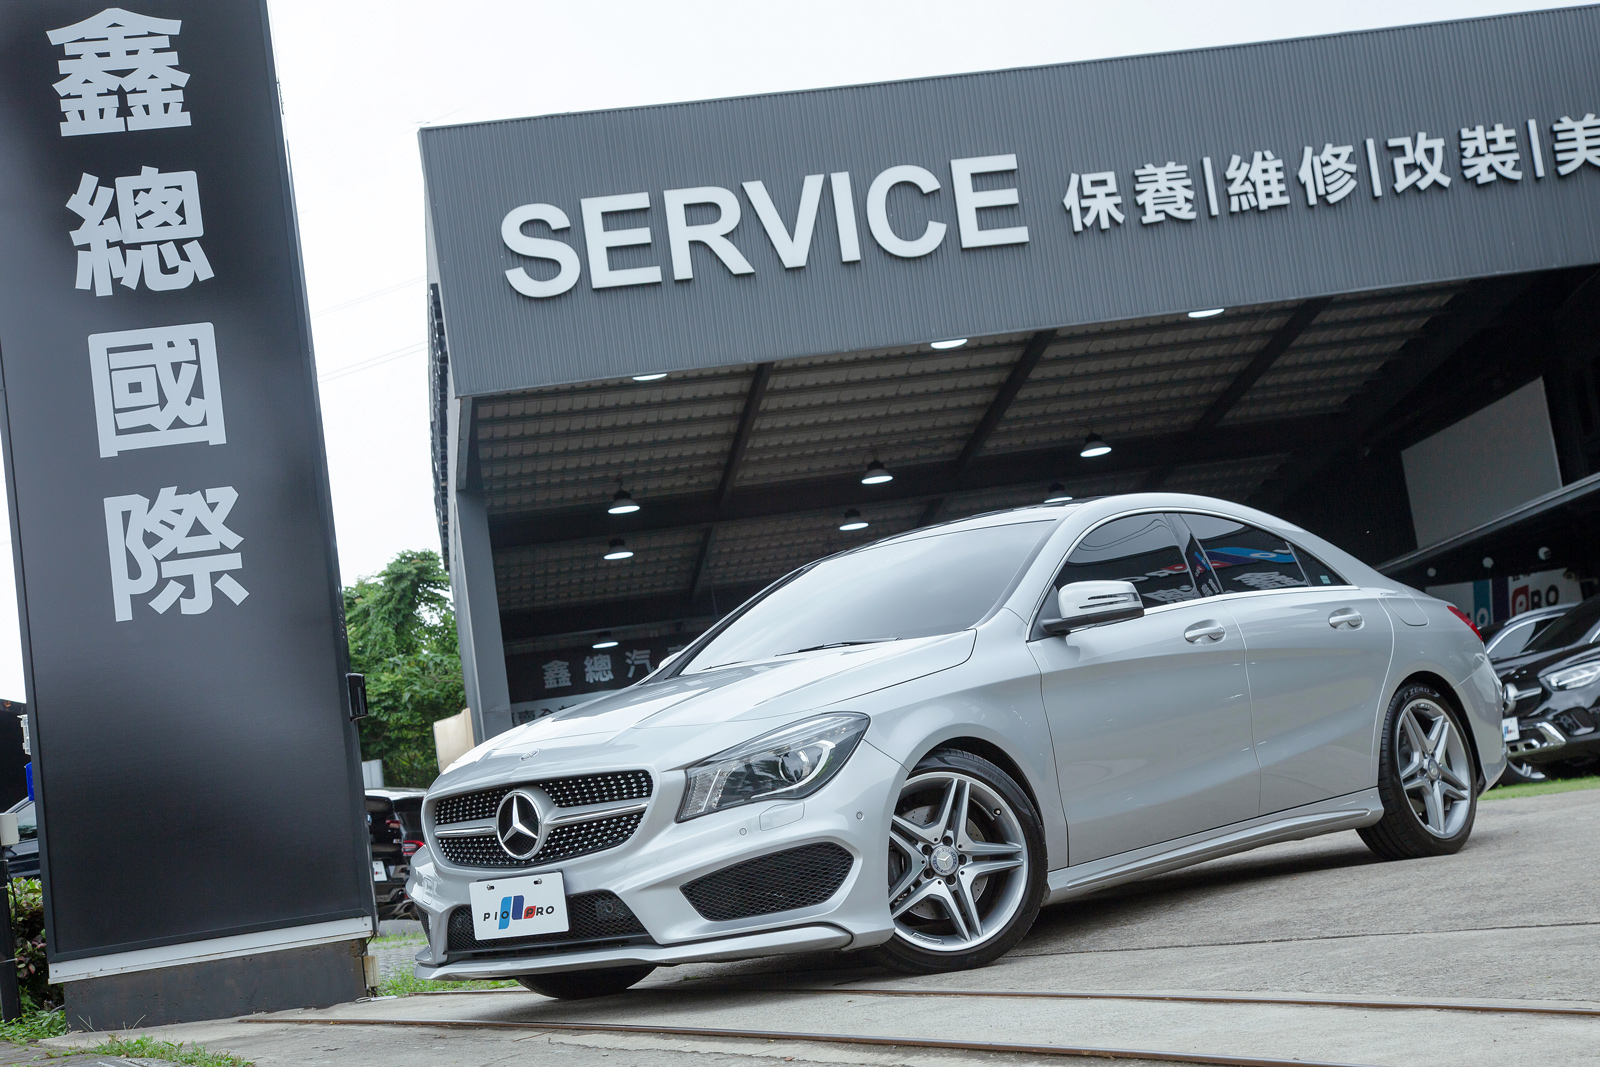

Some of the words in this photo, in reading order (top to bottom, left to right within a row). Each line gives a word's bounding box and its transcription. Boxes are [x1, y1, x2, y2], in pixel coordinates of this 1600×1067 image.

[500, 153, 1030, 298] SERVICE
[46, 7, 250, 622] 鑫總國際
[542, 645, 686, 689] 鑫總汽
[483, 910, 510, 921] PIO
[525, 905, 555, 917] PRO
